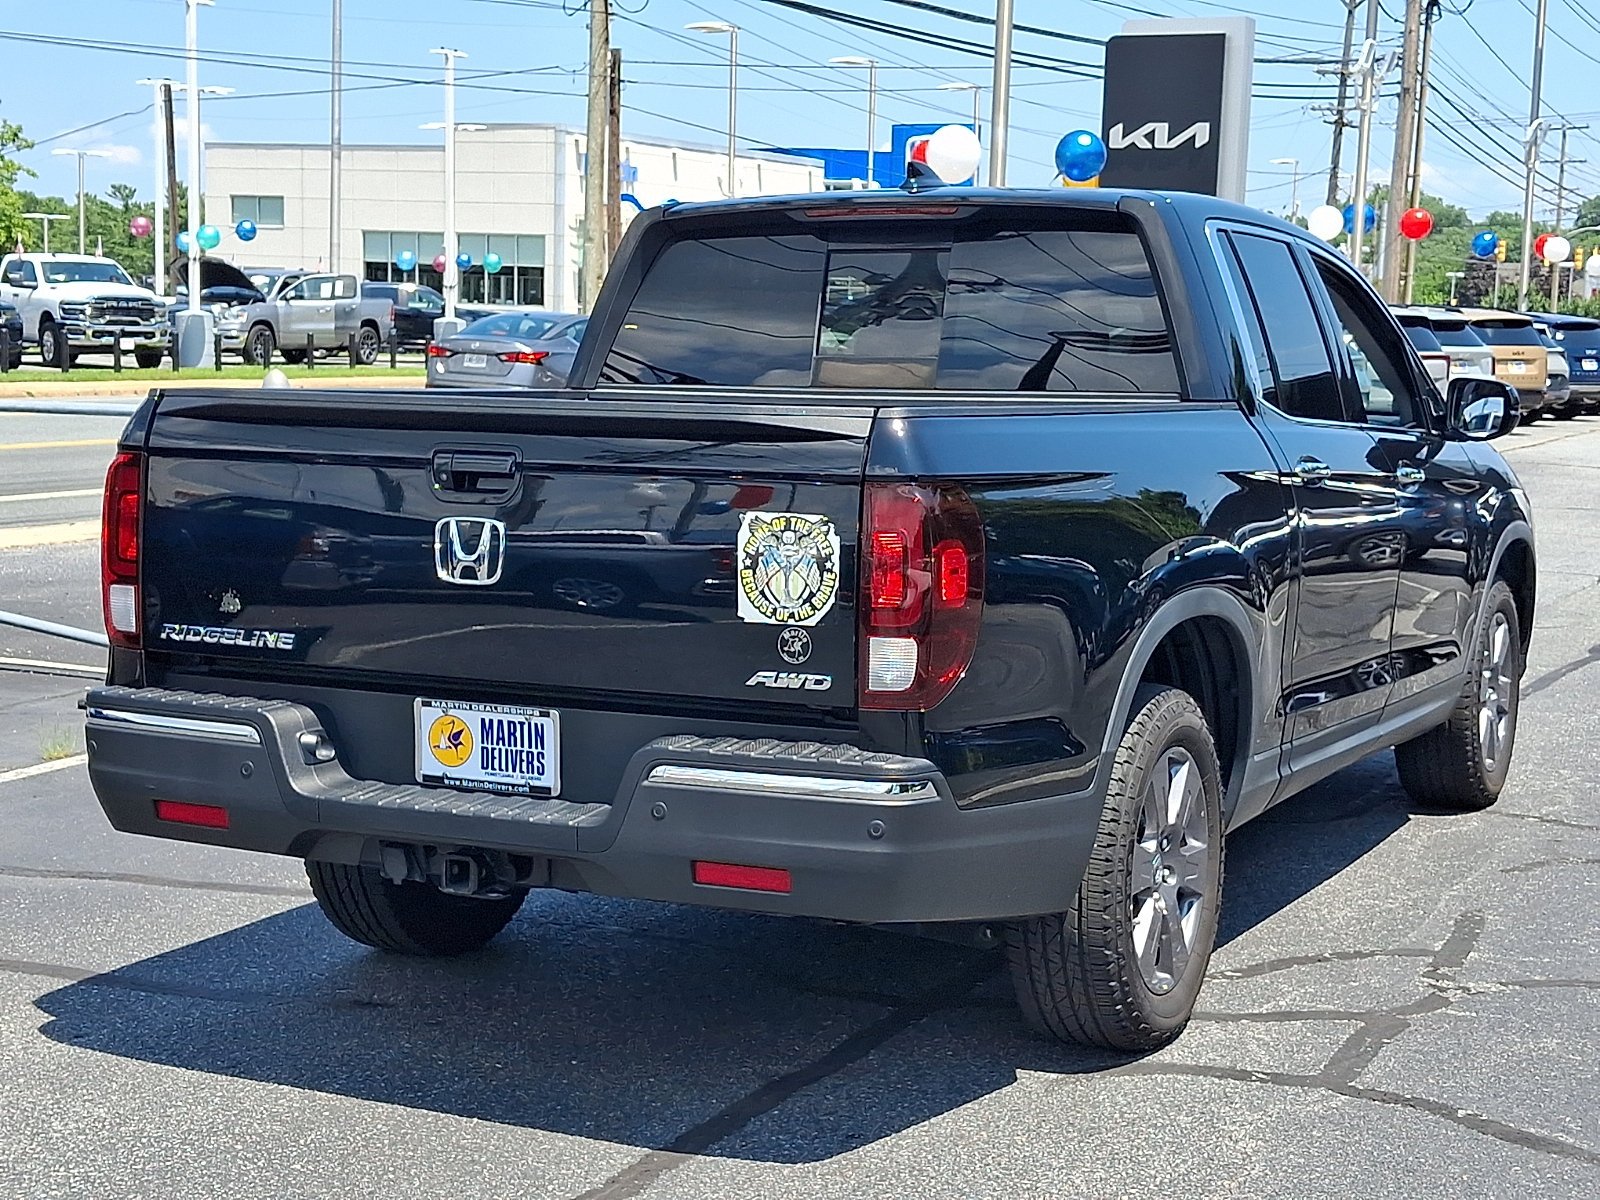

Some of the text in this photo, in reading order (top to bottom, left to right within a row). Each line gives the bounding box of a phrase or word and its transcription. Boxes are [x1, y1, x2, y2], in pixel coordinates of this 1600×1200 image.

[1108, 121, 1211, 149] KIA
[744, 517, 833, 557] HOME OF THE FREE
[741, 569, 836, 621] BECAUSE OF THE BRAVE
[160, 623, 296, 650] RIDGELINE
[745, 671, 832, 691] AWD
[431, 700, 540, 717] MARTIN DEALERSHIPS
[480, 717, 545, 750] MARTIN
[480, 746, 545, 776] DELIVERS
[443, 778, 530, 794] www.MartinDelivers.com
